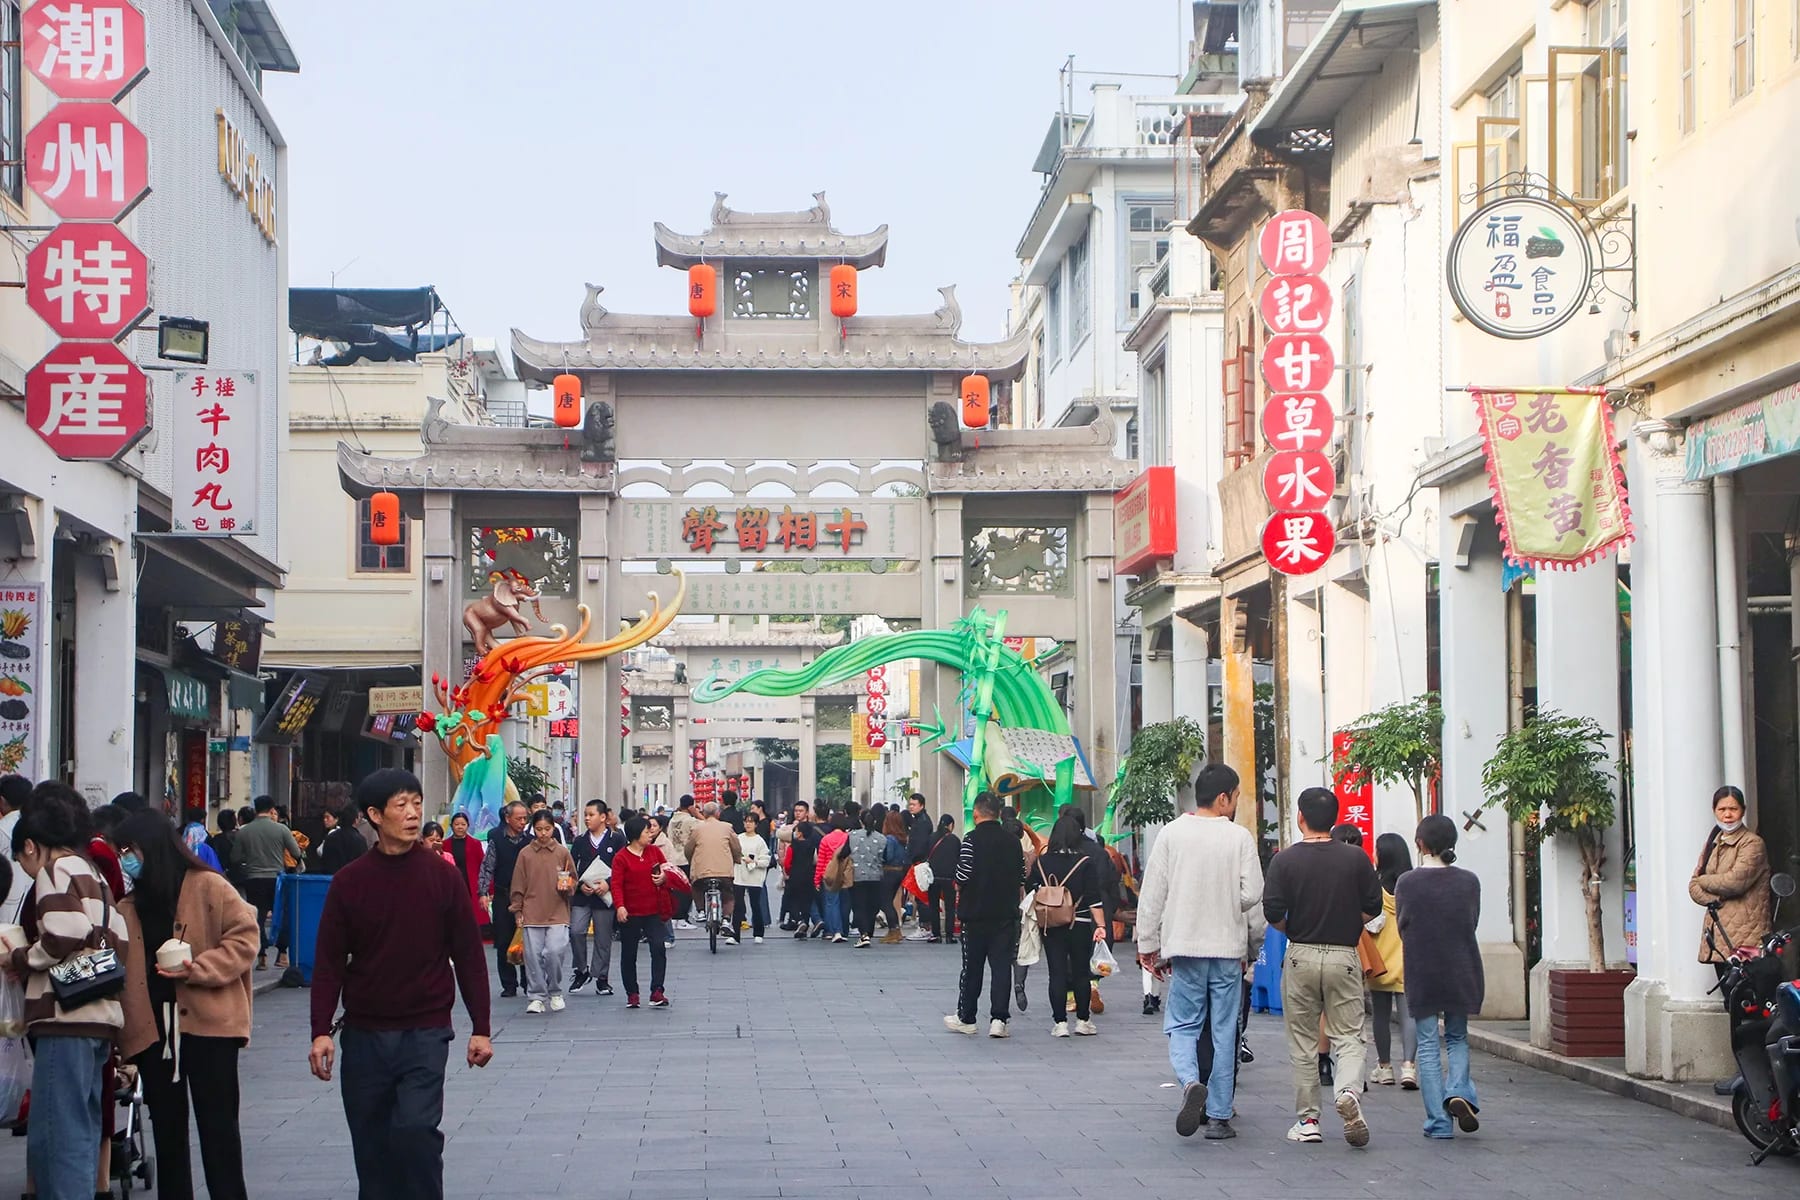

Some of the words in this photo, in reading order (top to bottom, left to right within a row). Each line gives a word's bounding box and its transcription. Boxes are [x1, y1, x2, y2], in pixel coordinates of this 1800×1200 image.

[690, 282, 704, 299] 唐
[836, 281, 852, 298] 宋
[1531, 265, 1557, 315] 食品
[557, 391, 574, 408] 唐
[965, 392, 980, 408] 宋
[1274, 218, 1328, 565] 周記甘草水果
[1493, 393, 1519, 436] 正宗
[192, 402, 233, 511] 牛肉丸
[191, 516, 236, 531] 包邮
[372, 511, 387, 527] 唐
